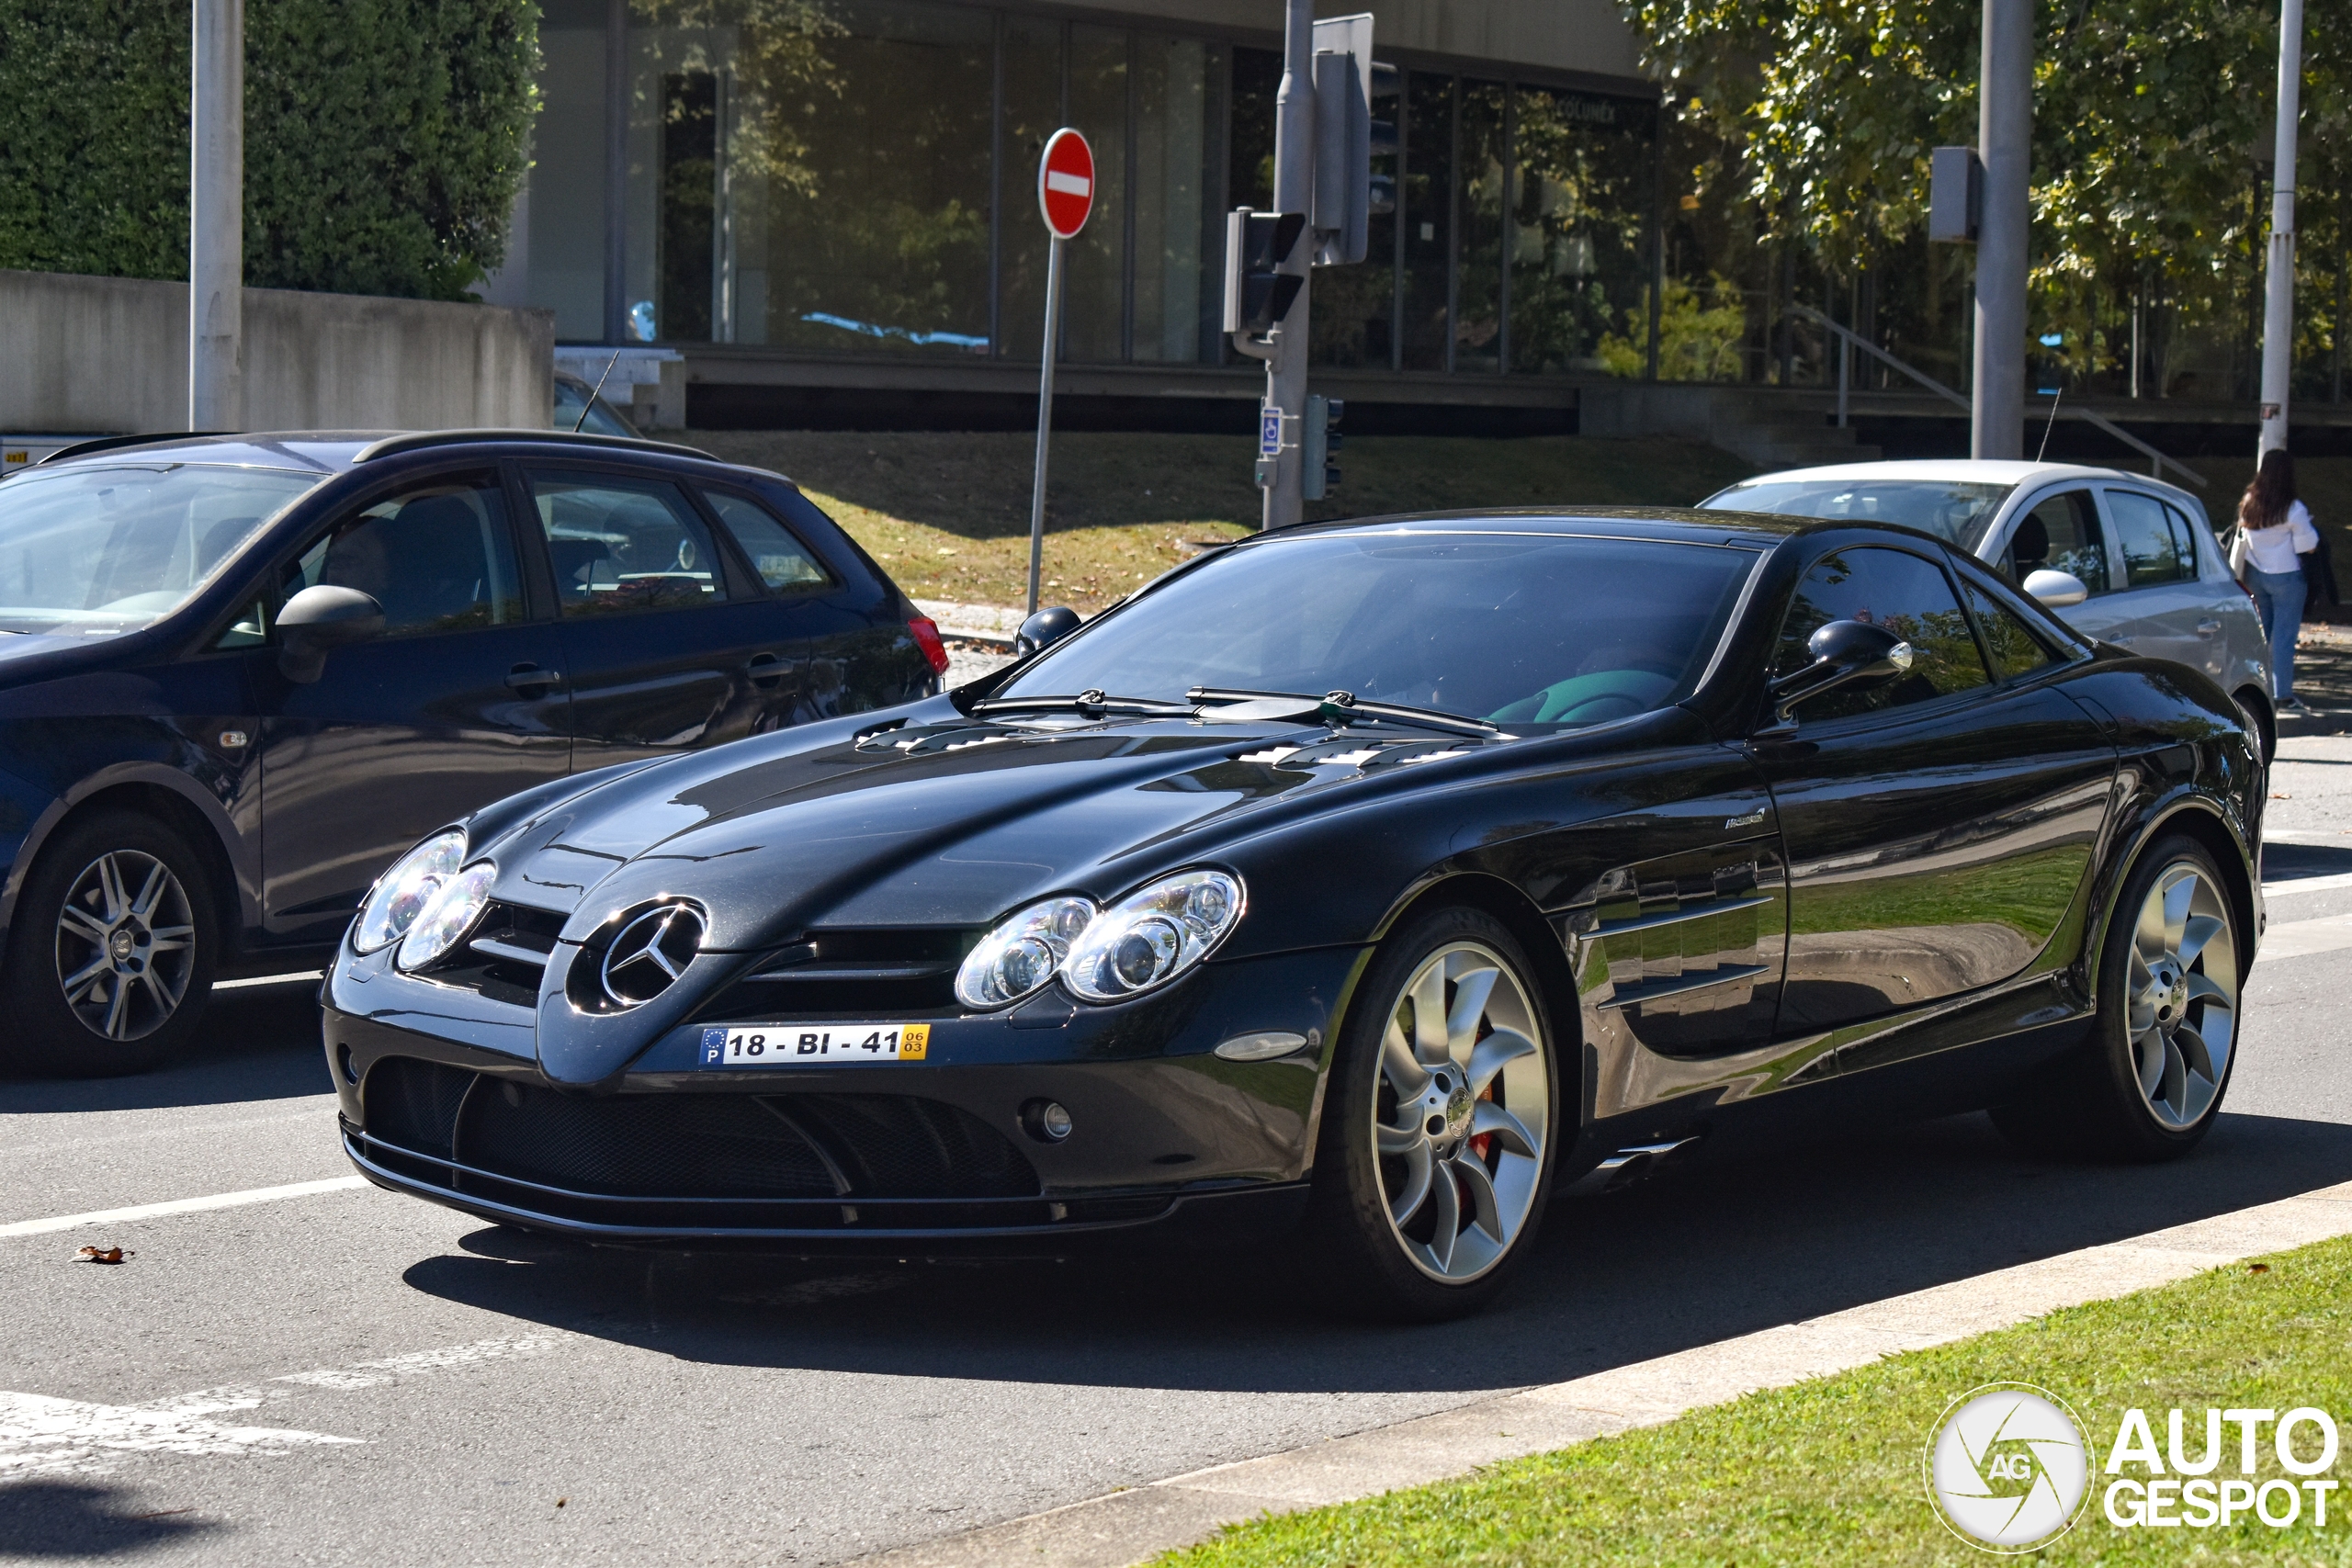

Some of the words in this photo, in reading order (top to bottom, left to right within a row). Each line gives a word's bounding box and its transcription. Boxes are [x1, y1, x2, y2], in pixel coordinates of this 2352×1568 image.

[905, 1032, 924, 1042] 06
[729, 1034, 765, 1056] 18
[797, 1032, 831, 1055] BI
[861, 1031, 899, 1054] 41
[903, 1042, 923, 1053] 03
[707, 1050, 719, 1063] P
